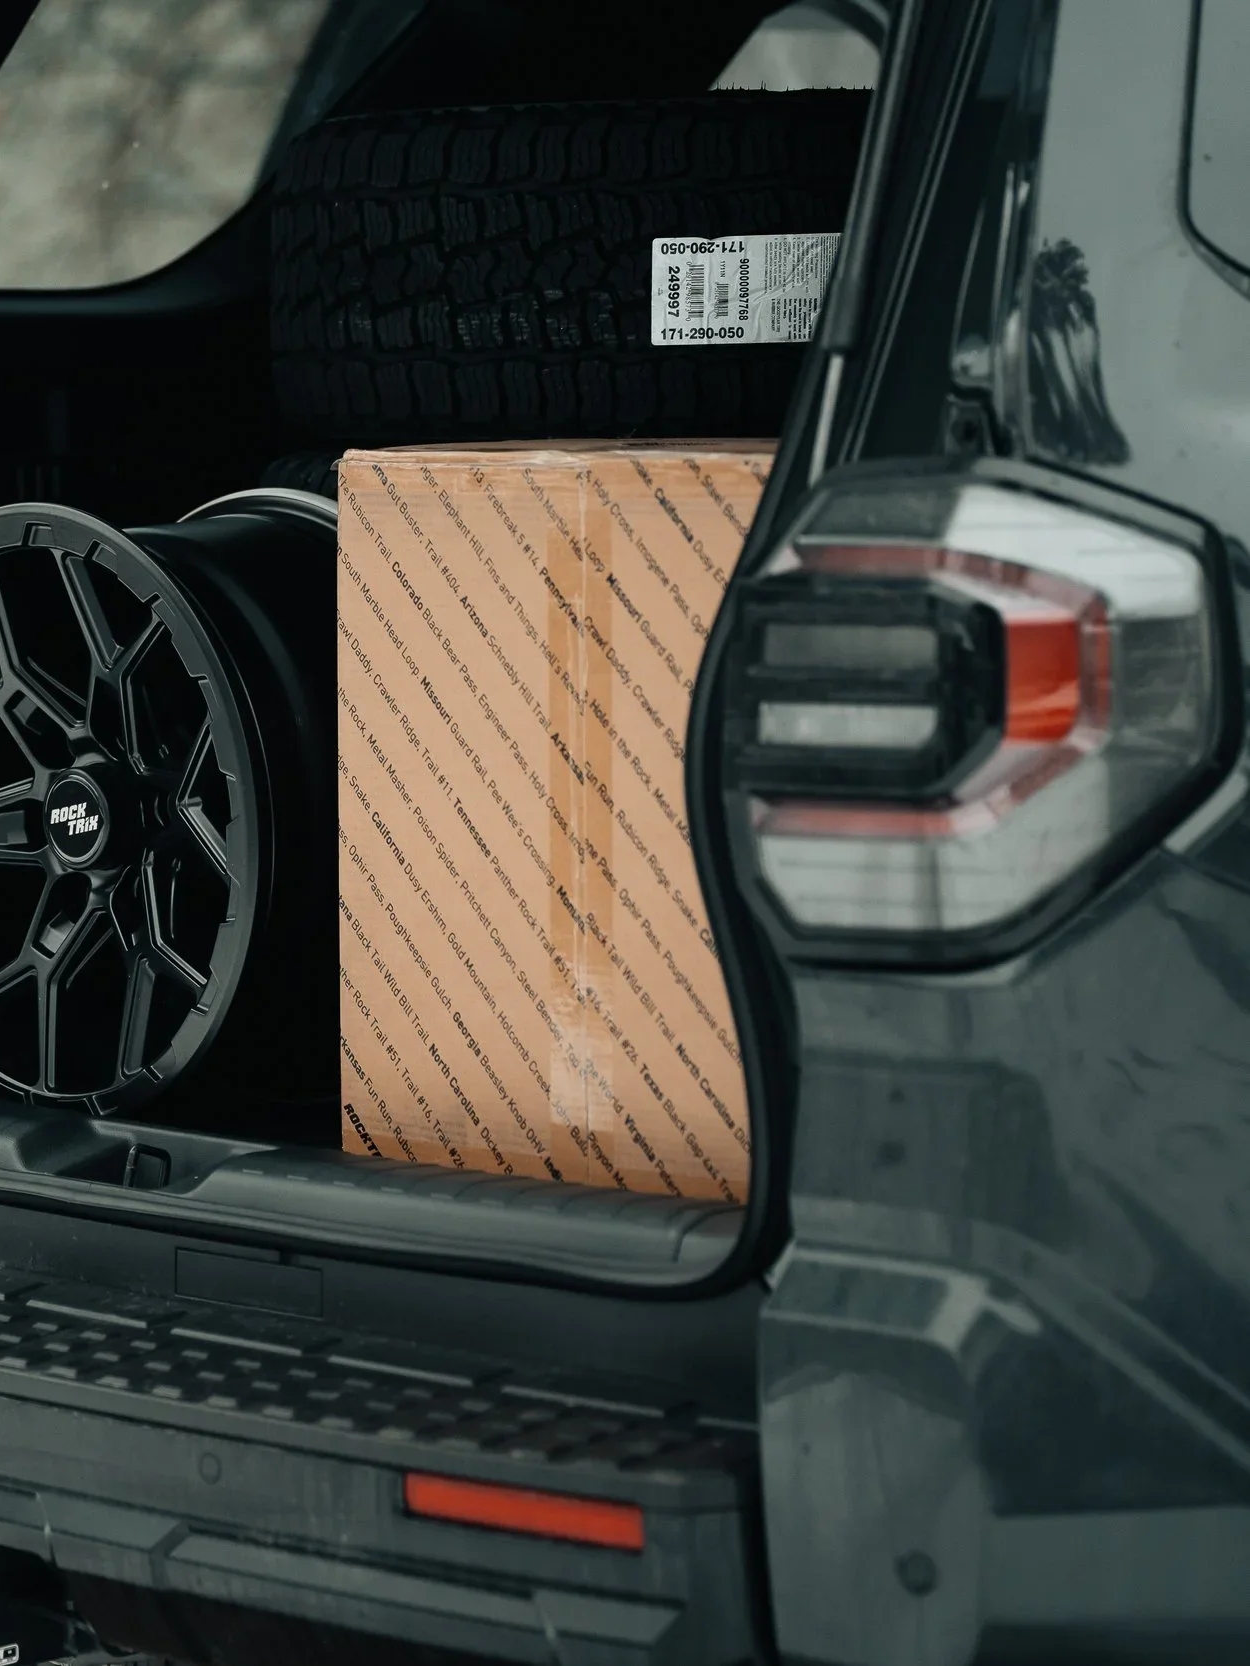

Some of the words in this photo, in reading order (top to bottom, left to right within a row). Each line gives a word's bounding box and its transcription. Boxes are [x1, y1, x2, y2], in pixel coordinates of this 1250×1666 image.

[660, 241, 745, 255] 171-290-050
[660, 326, 745, 340] 171-290-050
[668, 266, 681, 318] 249997
[738, 258, 750, 321] 90000097768
[437, 489, 471, 539] Elephant
[468, 534, 485, 562] Hill,
[483, 556, 501, 585] Fins
[498, 583, 516, 605] and
[513, 600, 539, 645] Things,
[539, 640, 562, 676] Hell's
[483, 482, 518, 537] Firebreak
[516, 533, 526, 546] 5
[347, 492, 375, 537] Rubicon
[374, 532, 393, 562] Trail.
[391, 560, 424, 611] Colorado
[421, 607, 443, 642] Black
[441, 637, 461, 666] Bear
[458, 663, 478, 698] Pass,
[478, 693, 512, 742] Engineer
[509, 740, 529, 775] Pass,
[528, 770, 548, 800] Holy
[546, 796, 569, 836] Cross,
[386, 482, 402, 506] Gut
[398, 501, 424, 544] Buster,
[424, 538, 443, 569] Trail
[440, 565, 461, 597] #404.
[459, 595, 489, 639] Arizona
[486, 634, 520, 686] Schnebly
[518, 682, 535, 706] Hill
[532, 701, 553, 734] Trail.
[50, 801, 87, 825] ROCK
[340, 552, 362, 586] South
[359, 582, 385, 623] Marble
[383, 618, 405, 650] Head
[401, 646, 420, 680] Loop.
[419, 675, 454, 725] Missouri
[450, 722, 474, 758] Guard
[470, 754, 488, 784] Rail,
[487, 779, 503, 805] Pee
[501, 800, 525, 838] Wee's
[522, 834, 556, 889] Crossing.
[350, 637, 374, 678] Daddy,
[373, 673, 402, 716] Crawler
[399, 714, 421, 752] Ridge,
[421, 746, 440, 777] Trail
[436, 774, 453, 801] #11.
[453, 796, 492, 859] Tennessee
[489, 855, 520, 900] Panther
[517, 898, 538, 931] Rock
[536, 926, 557, 958] Trail
[553, 955, 570, 984] #51,
[347, 704, 367, 738] Rock,
[366, 733, 389, 766] Metal
[385, 763, 413, 811] Masher,
[412, 806, 437, 846] Poison
[435, 842, 460, 885] Spider,
[459, 880, 492, 930] Pritchett
[489, 927, 517, 974] Canyon,
[516, 970, 539, 1003] Steel
[348, 775, 371, 814] Snake.
[371, 811, 406, 867] California
[403, 862, 423, 893] Dusy
[420, 889, 447, 936] Ershim,
[447, 932, 467, 961] Gold
[463, 957, 497, 1014] Mountain,
[496, 1010, 530, 1063] Holcomb
[528, 1060, 551, 1102] Creek,
[348, 844, 369, 875] Ophir
[366, 873, 385, 907] Pass,
[384, 902, 432, 979] Poughkeepsie
[430, 976, 452, 1014] Gulch.
[452, 1011, 482, 1058] Georgia
[479, 1054, 509, 1101] Beasley
[506, 1098, 527, 1131] Knob
[525, 1128, 547, 1161] OHV.
[351, 918, 372, 953] Black
[370, 948, 387, 974] Tail
[383, 968, 402, 998] Wild
[398, 994, 414, 1018] Bill
[411, 1012, 430, 1047] Trail.
[428, 1042, 451, 1080] North
[449, 1076, 481, 1127] Carolina
[480, 1126, 507, 1168] Dickey
[352, 989, 372, 1020] Rock
[370, 1016, 389, 1047] Trail
[385, 1044, 402, 1072] #51,
[401, 1066, 420, 1097] Trail
[416, 1095, 433, 1124] #16,
[432, 1118, 451, 1150] Trail
[363, 1077, 379, 1103] Fun
